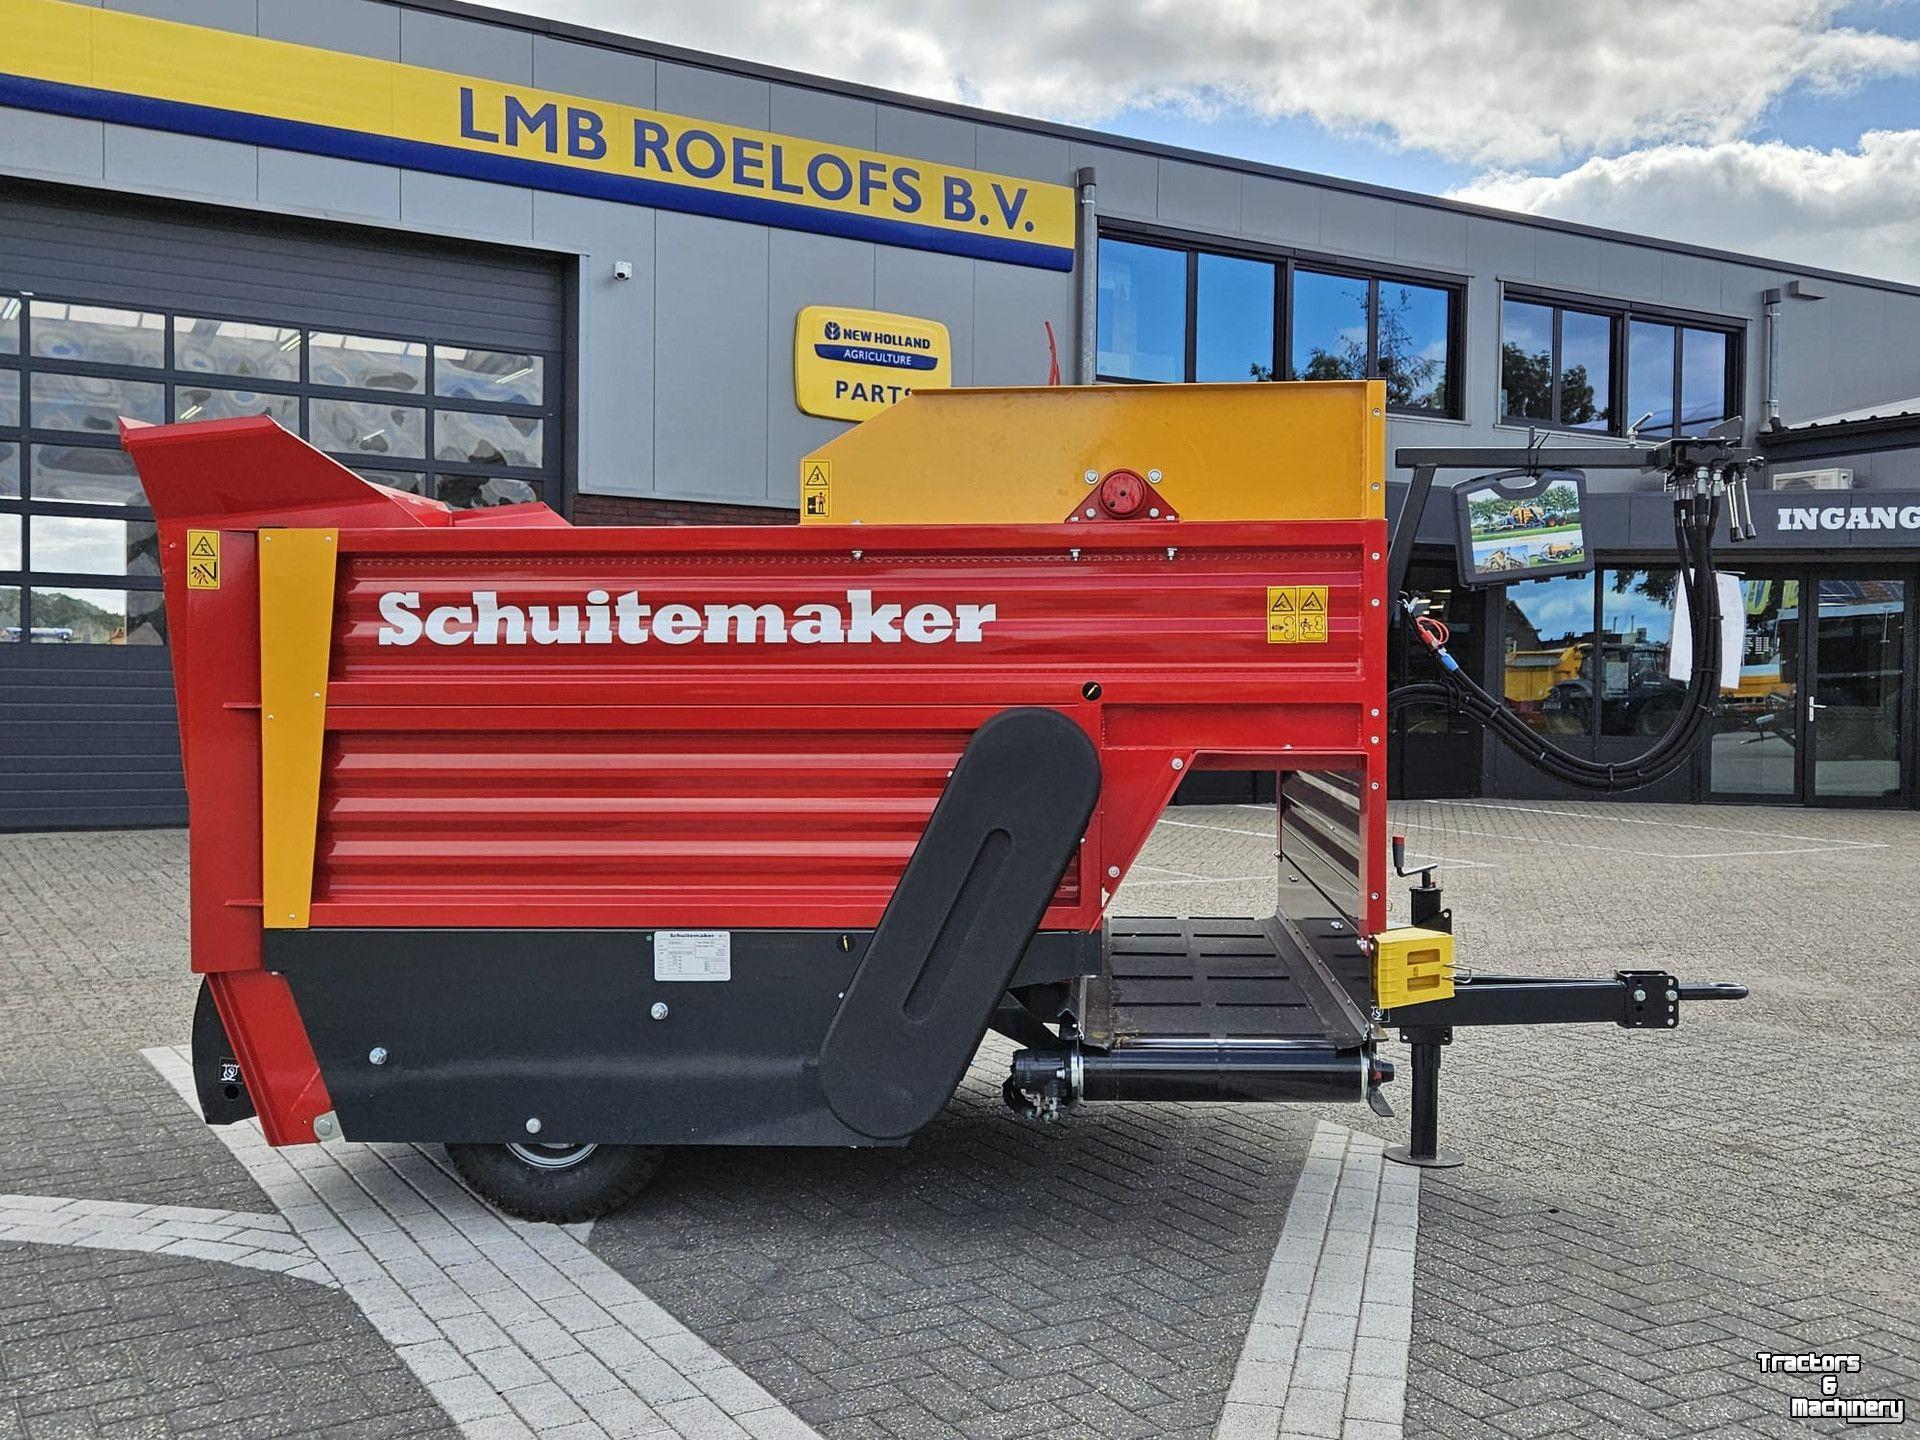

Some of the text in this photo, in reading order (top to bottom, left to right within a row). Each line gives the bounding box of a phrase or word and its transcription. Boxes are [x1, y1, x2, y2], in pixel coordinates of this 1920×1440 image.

[460, 88, 1034, 232] LMB ROELOFS B.V.
[843, 328, 930, 349] NEW HOLLAND
[843, 350, 912, 365] AGRICULTURE
[1777, 506, 1920, 531] INGANG
[378, 589, 997, 646] Schuitemaker
